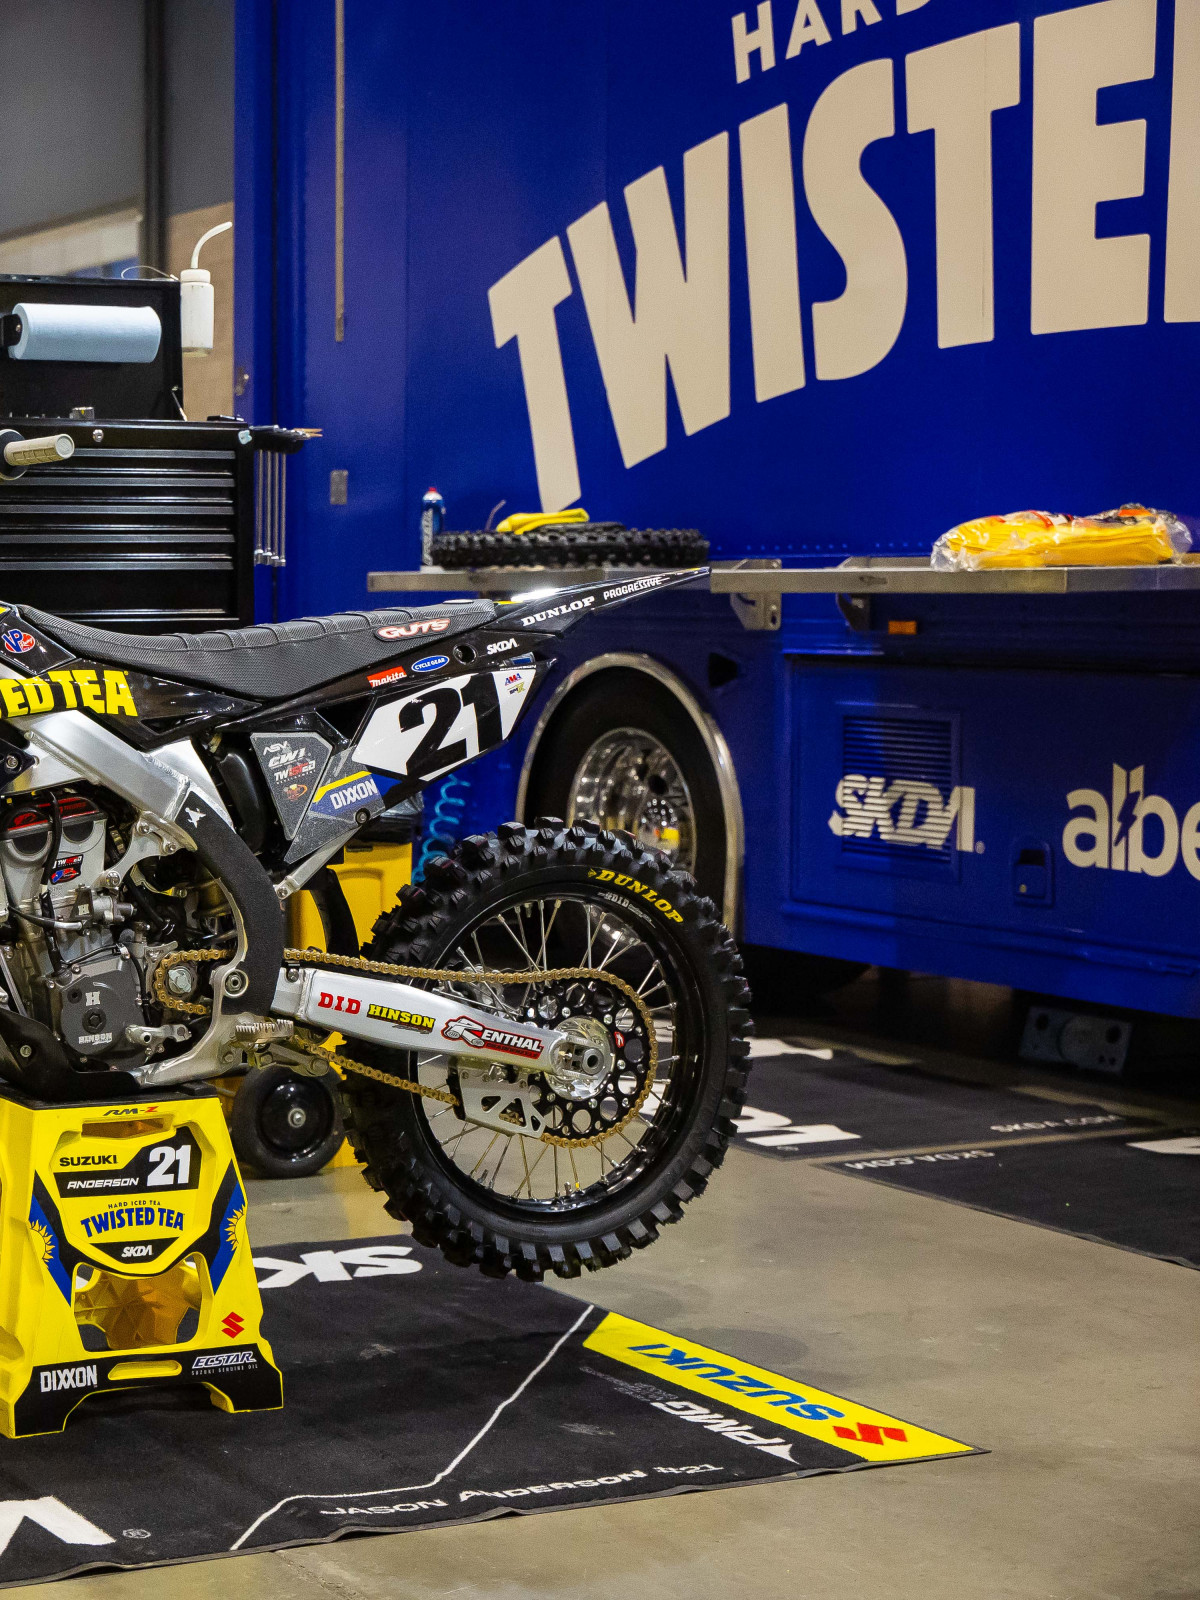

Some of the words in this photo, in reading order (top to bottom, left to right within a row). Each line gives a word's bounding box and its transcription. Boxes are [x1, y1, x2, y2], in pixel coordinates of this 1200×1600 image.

[731, 0, 931, 84] HAR
[488, 0, 1200, 514] TWISTE
[603, 577, 663, 601] PROGRESSIVE
[521, 596, 596, 627] DUNLOP
[378, 618, 451, 639] GUTS
[487, 638, 519, 655] SKDA
[414, 659, 431, 670] CYCLE
[431, 657, 446, 667] GEAR
[48, 669, 138, 717] TEA
[399, 673, 503, 776] 21
[330, 779, 379, 810] DIXXON
[828, 774, 976, 853] SKDA
[596, 870, 684, 922] DUNLOP
[368, 1004, 436, 1030] HINSON
[103, 1105, 159, 1116] RM-Z
[59, 1155, 119, 1167] SUZUKI
[146, 1145, 192, 1187] 21
[67, 1177, 139, 1190] ANDERSON
[108, 1201, 128, 1209] HARD
[81, 1207, 155, 1238] TWISTED
[158, 1208, 184, 1232] TEA
[121, 1245, 153, 1258] SKDA
[191, 1350, 257, 1370] ECSTAR
[40, 1365, 98, 1393] DIXXON
[627, 1343, 846, 1421] SUZUKI
[320, 1498, 449, 1516] JASON
[459, 1469, 648, 1503] ANDERSON
